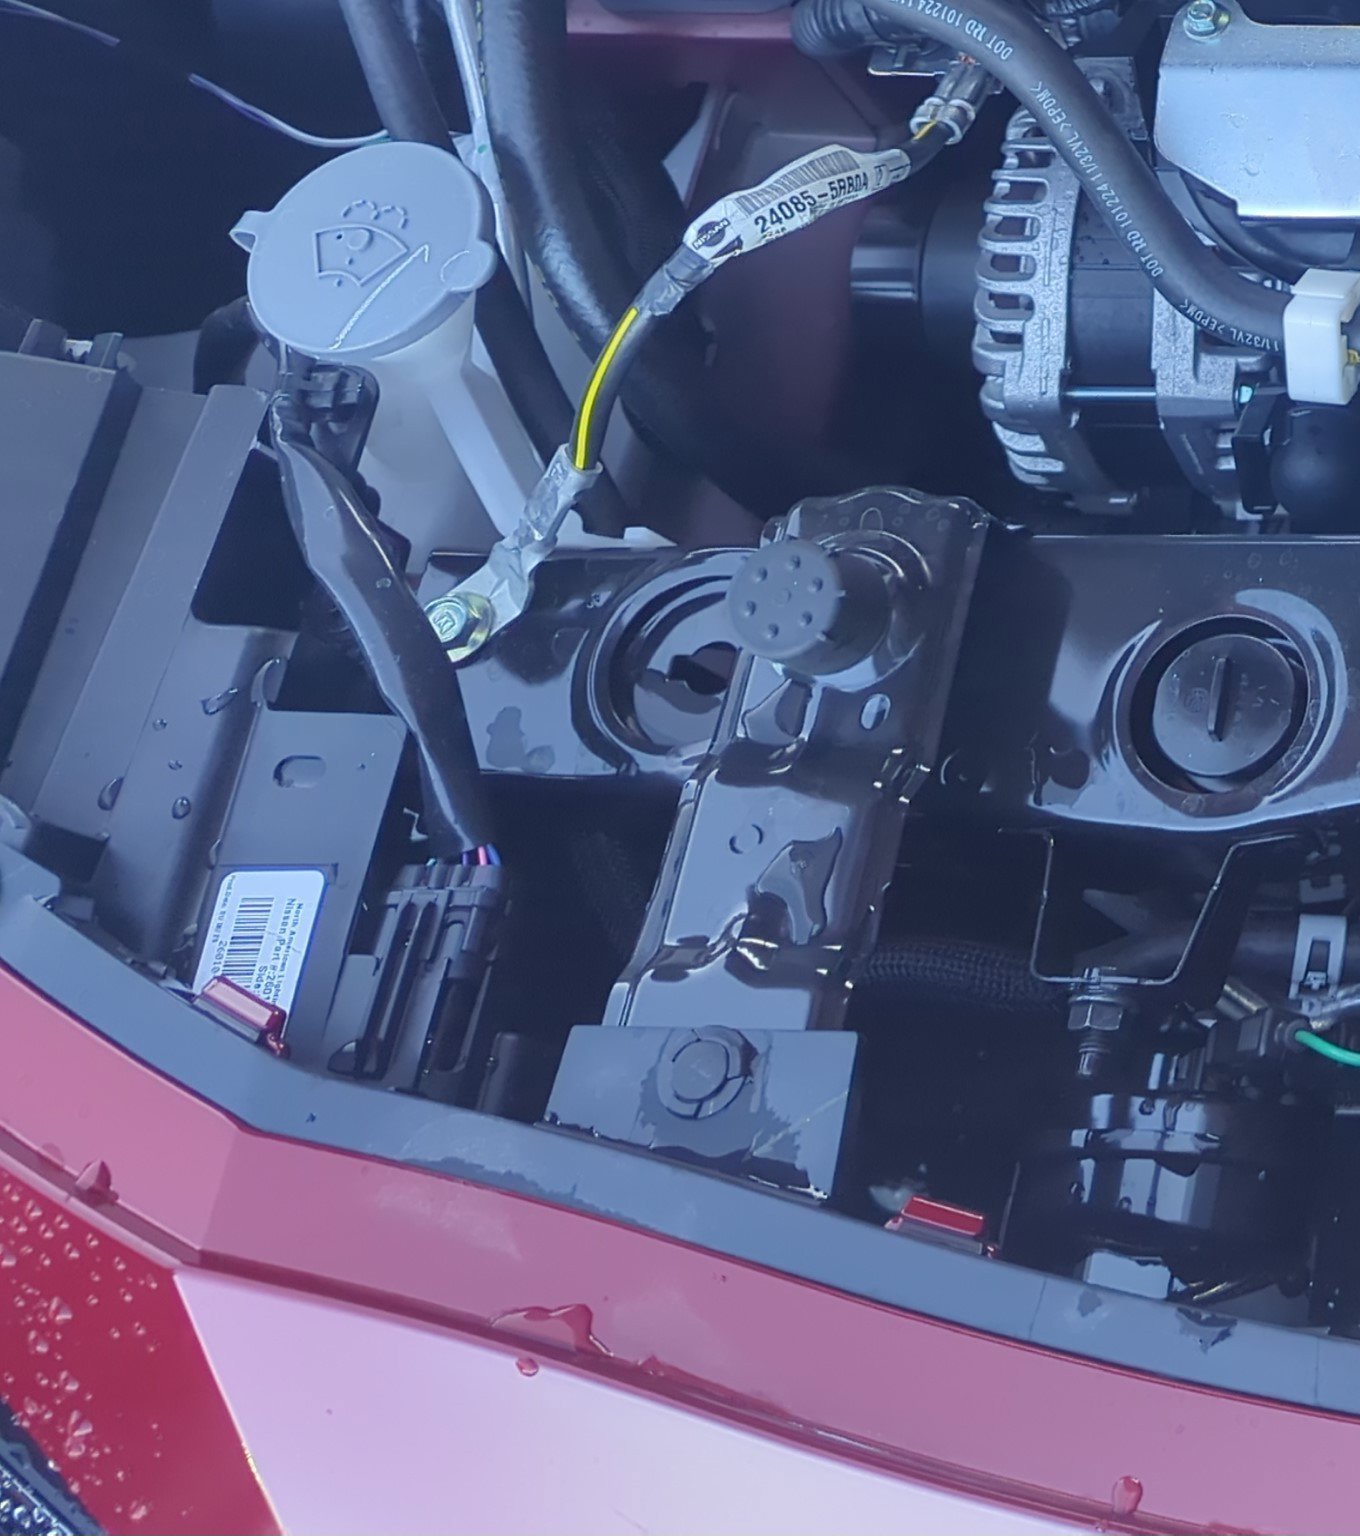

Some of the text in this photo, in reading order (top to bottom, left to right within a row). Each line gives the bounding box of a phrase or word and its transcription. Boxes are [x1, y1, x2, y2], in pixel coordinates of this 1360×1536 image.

[986, 36, 1014, 61] DOT
[1030, 81, 1072, 131] >EPDM<
[1066, 130, 1101, 183] 11/32VL
[1095, 182, 1130, 230] 101224
[693, 218, 730, 250] NISSAN
[1139, 253, 1165, 278] DOT
[1179, 298, 1226, 334] >EPDM<
